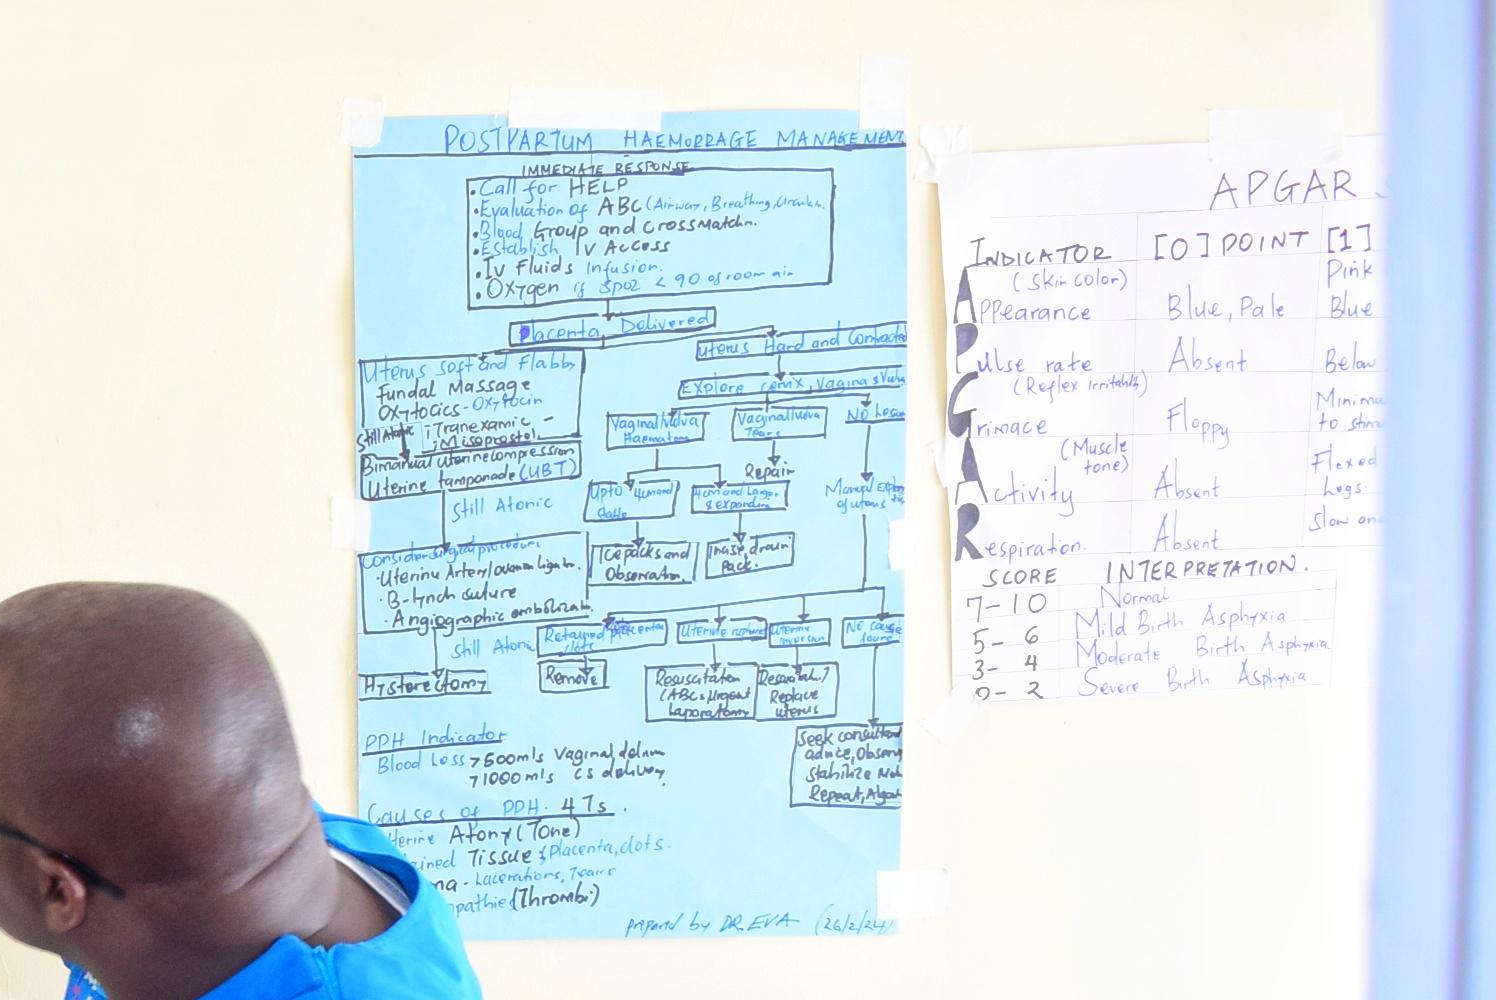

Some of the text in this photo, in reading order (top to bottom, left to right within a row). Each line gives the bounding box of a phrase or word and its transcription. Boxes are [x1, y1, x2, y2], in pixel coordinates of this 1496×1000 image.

[445, 124, 592, 154] POSTPARTUM
[615, 161, 690, 174] RESPONSE
[522, 180, 557, 203] for
[570, 178, 628, 198] HELP
[1210, 169, 1357, 211] APGAR
[598, 196, 642, 216] ABC
[599, 217, 635, 235] and
[1223, 231, 1309, 256] POINT
[1328, 224, 1371, 253] [1]
[675, 273, 699, 287] 90
[1328, 258, 1373, 288] Pink
[1330, 290, 1374, 319] Blue
[1046, 351, 1093, 372] rate
[1168, 336, 1247, 373] Absent
[449, 379, 530, 400] Massage
[1167, 397, 1230, 450] Floppy
[1319, 412, 1339, 432] to
[1061, 433, 1127, 461] (Muscle
[519, 458, 577, 483] (UBT)
[1084, 455, 1128, 475] tone)
[1153, 457, 1221, 499] Absent
[453, 495, 553, 523] Still Atonic
[1153, 509, 1220, 553] Absent
[983, 568, 1057, 588] SCORE
[1100, 585, 1170, 609] Normal
[1076, 608, 1127, 639] Mild
[1076, 638, 1161, 668] Moderate
[1196, 635, 1245, 657] Birth
[546, 665, 598, 685] Remove
[1078, 666, 1140, 696] Severe
[422, 721, 508, 746] Indicator
[377, 752, 421, 774] Blood
[554, 743, 613, 766] Vaginal
[368, 802, 445, 826] Causes
[516, 816, 580, 842] (Tone)
[468, 849, 532, 867] Tissue
